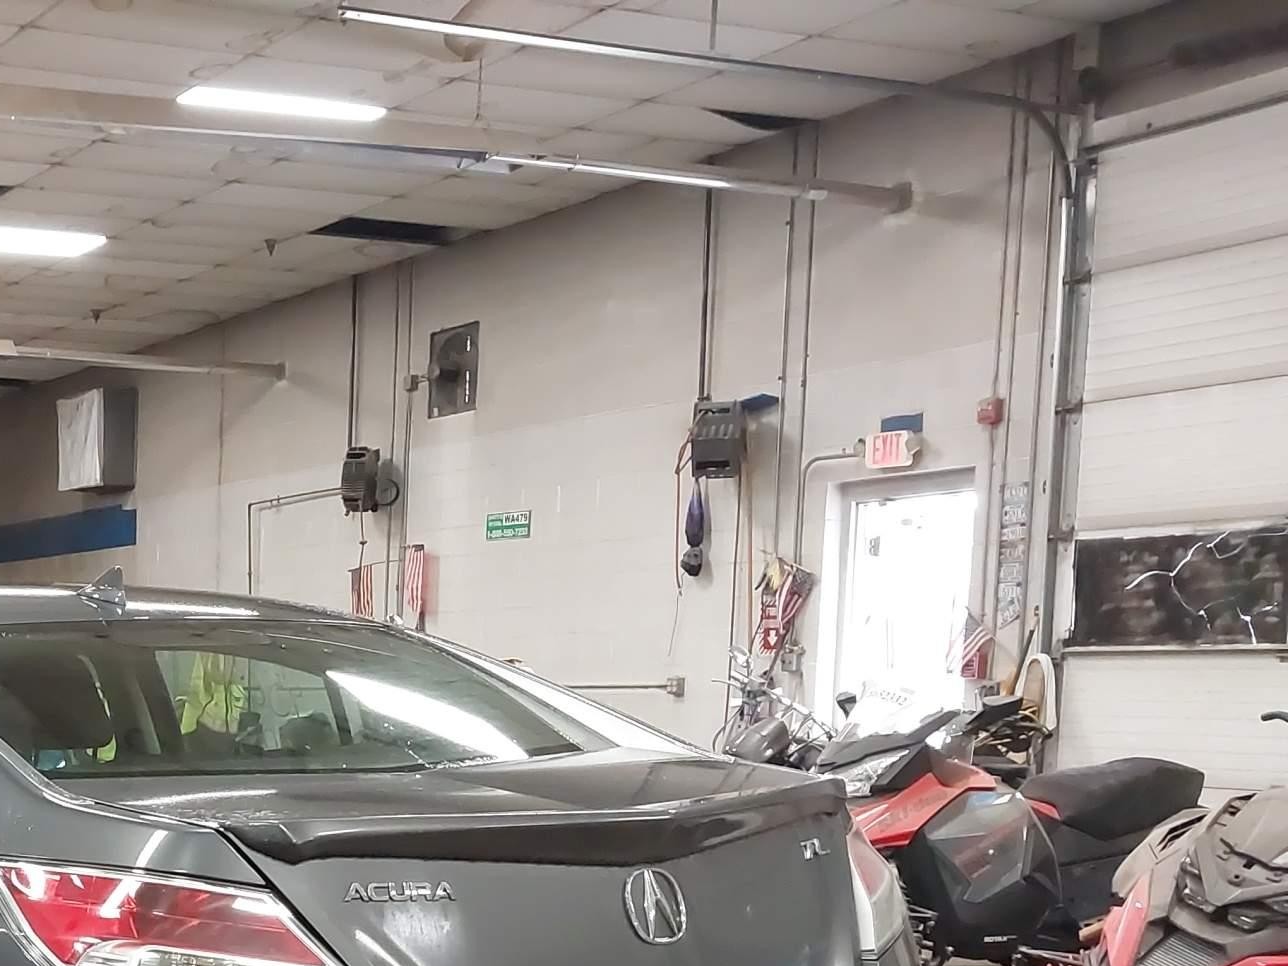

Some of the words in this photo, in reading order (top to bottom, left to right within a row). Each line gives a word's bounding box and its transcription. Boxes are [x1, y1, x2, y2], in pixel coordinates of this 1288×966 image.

[872, 433, 902, 465] EXIT
[504, 513, 528, 523] WA479
[343, 880, 456, 903] ACURA
